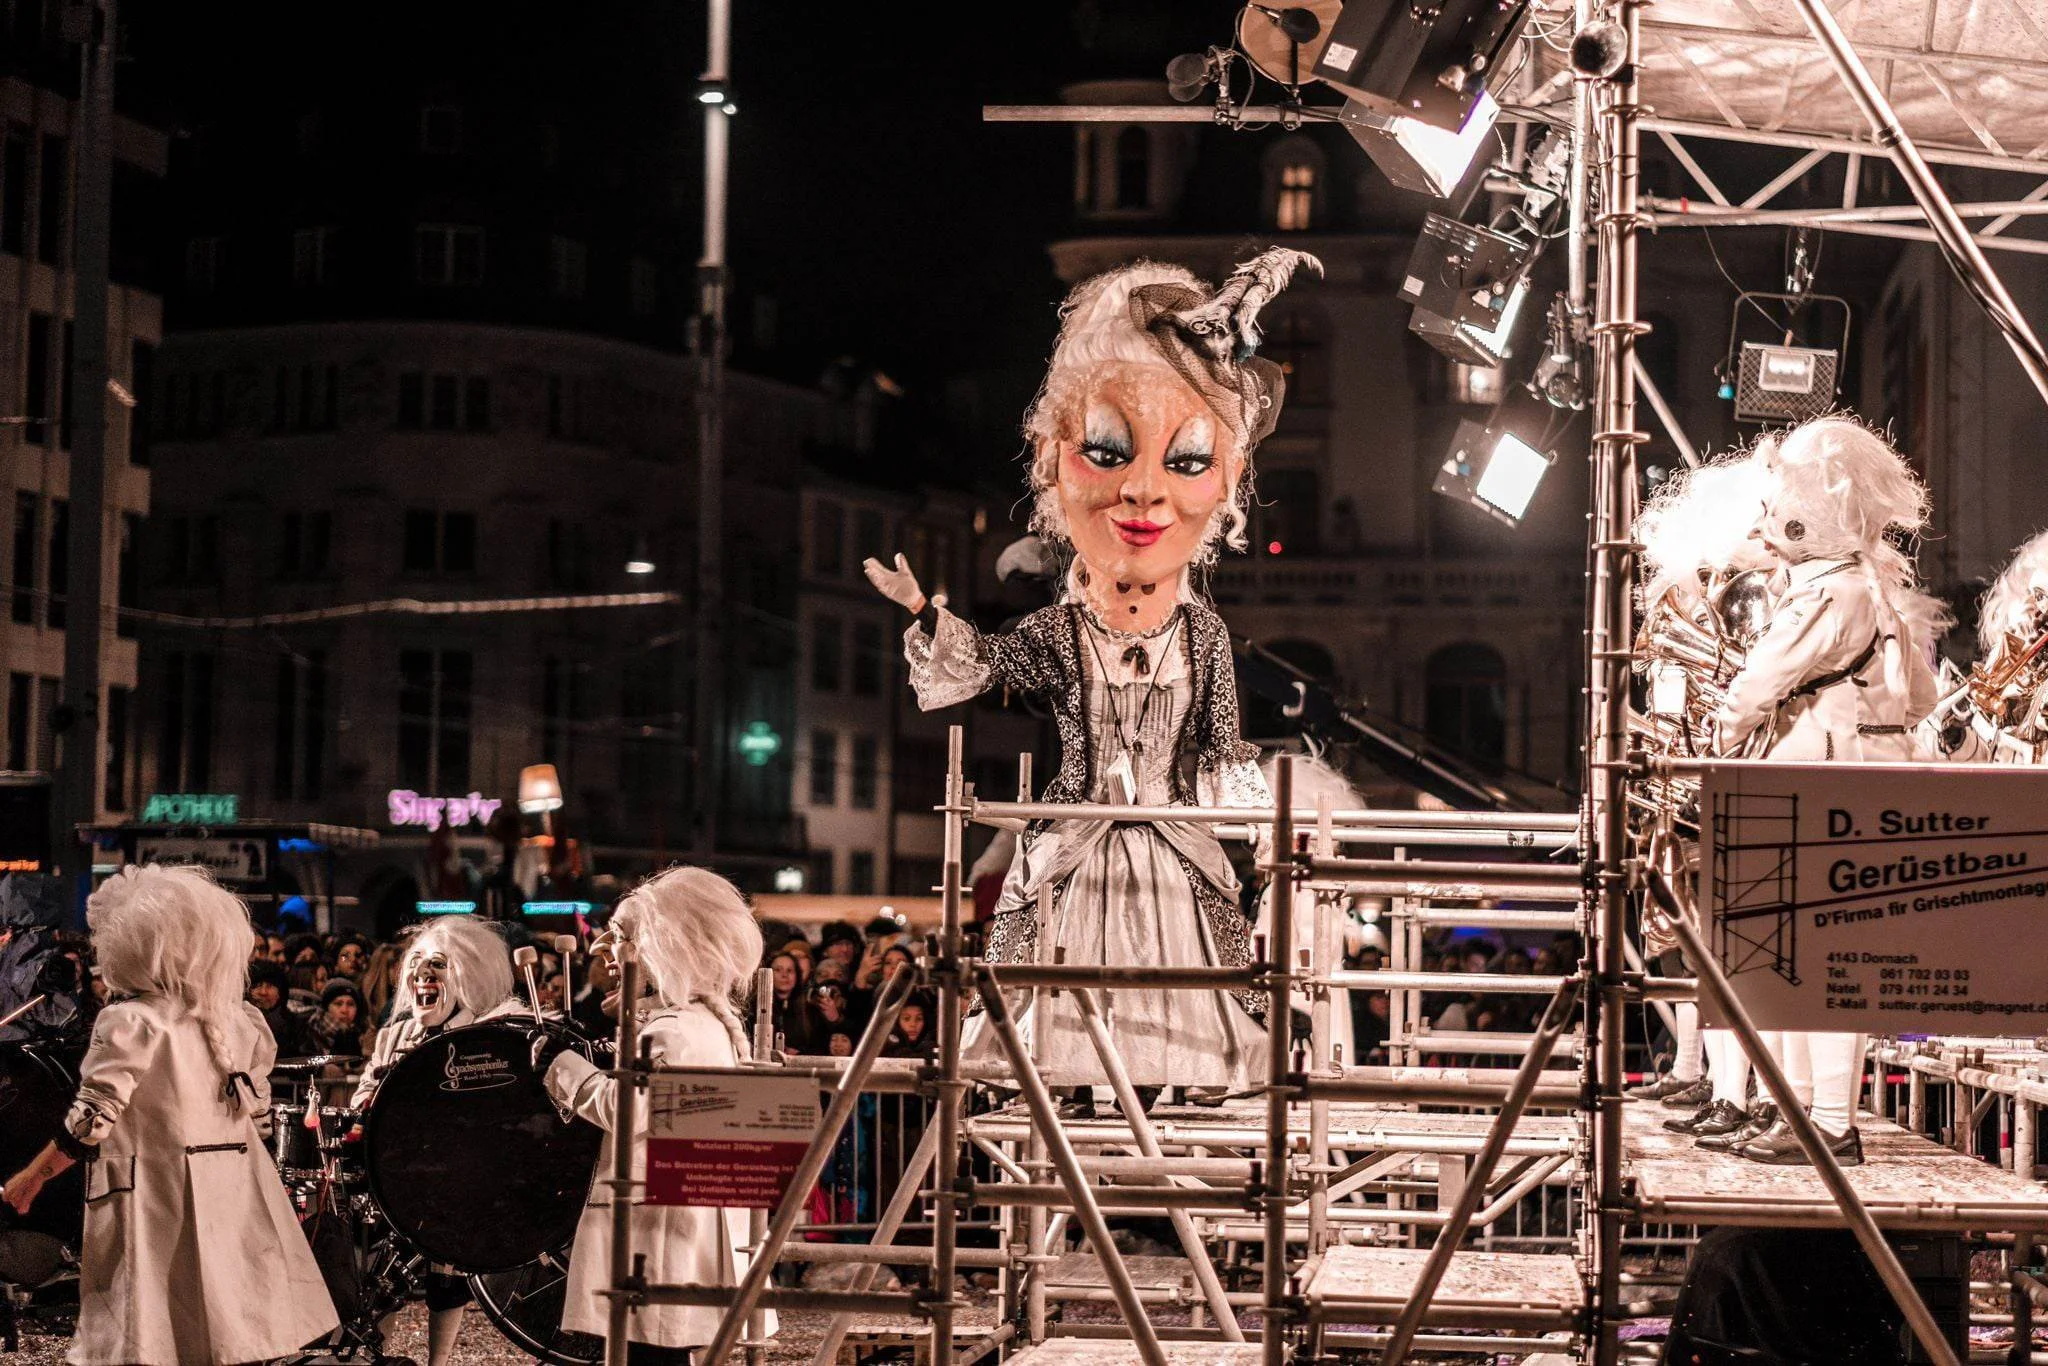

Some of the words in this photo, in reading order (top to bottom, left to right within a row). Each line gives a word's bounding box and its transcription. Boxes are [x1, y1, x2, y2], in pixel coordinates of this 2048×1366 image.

[1828, 808, 1862, 838] D.
[1879, 809, 1990, 836] Sutter
[1828, 851, 2027, 893] Gerüstbau
[1814, 905, 1884, 928] D'Firma
[1888, 899, 1908, 916] fir
[1913, 881, 2048, 913] Grischtmontag
[1827, 952, 1858, 963] 4143
[1861, 952, 1918, 964] Dornach
[1827, 967, 1849, 978] Tel.
[1880, 968, 1903, 979] 061
[1908, 969, 1931, 980] 702
[1826, 983, 1861, 994] Natel
[1879, 984, 1903, 995] 079
[1906, 984, 1929, 995] 411
[1933, 985, 1949, 996] 24
[1953, 985, 1969, 996] 34
[1826, 998, 1868, 1010] E-Mail
[1878, 1000, 2048, 1015] sutter.geruest@magnet.c
